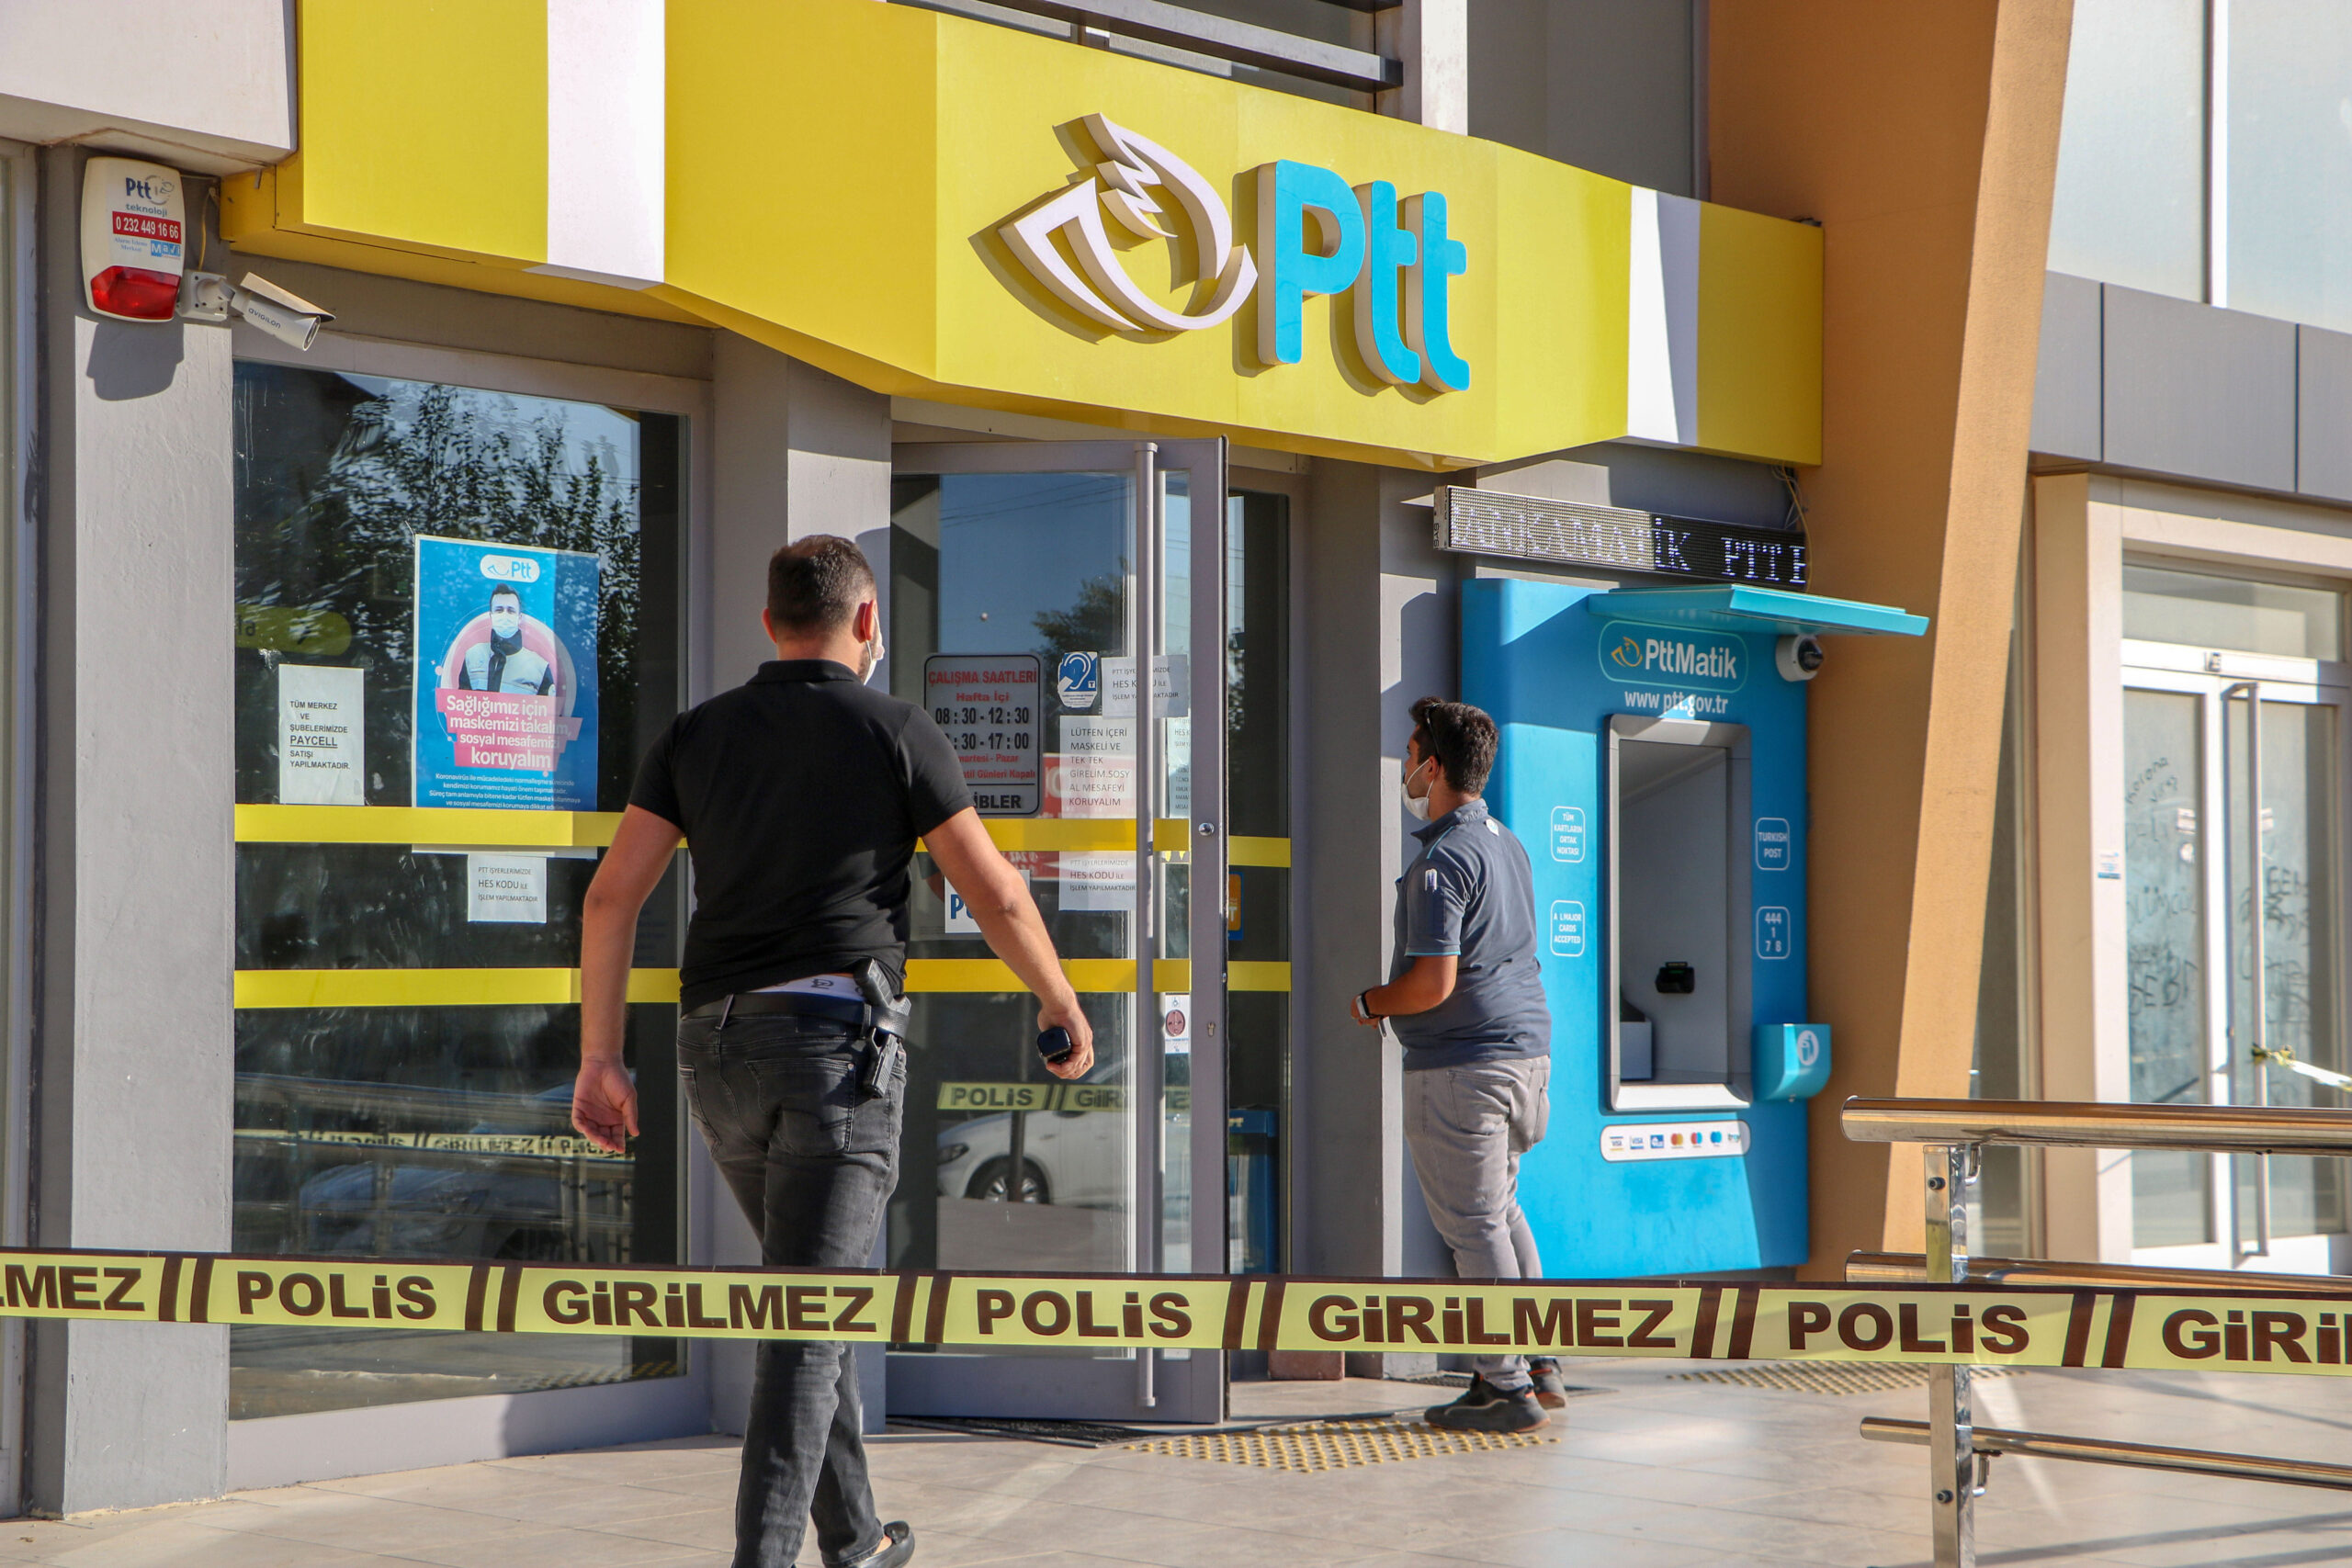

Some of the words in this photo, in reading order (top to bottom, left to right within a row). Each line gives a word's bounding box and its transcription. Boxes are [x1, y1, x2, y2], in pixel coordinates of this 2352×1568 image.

[125, 176, 152, 200] Ptt
[126, 204, 167, 218] teknoloji
[116, 216, 121, 230] 0
[123, 217, 140, 232] 232
[141, 220, 156, 235] 449
[158, 222, 168, 237] 16
[169, 224, 179, 240] 66
[1272, 158, 1470, 391] Ptt
[512, 561, 532, 579] Ptt
[1645, 638, 1736, 680] PttMatik
[928, 671, 978, 687] ÇALIŞMA
[982, 668, 1037, 684] SAATLERİ
[1113, 681, 1129, 689] HES
[956, 693, 990, 702] Hafta
[994, 691, 1010, 703] İçi
[290, 700, 306, 708] TÜM
[307, 702, 338, 710] MERKEZ
[447, 695, 520, 717] Sağlığımız
[522, 700, 548, 721] için
[935, 707, 950, 725] 08
[962, 707, 977, 724] 30
[989, 707, 1003, 724] 12
[1014, 707, 1030, 724] 30
[290, 724, 348, 733] ŞUBELERİMİZDE
[450, 716, 519, 733] maskemizi
[1070, 728, 1103, 737] LÜTFEN
[1106, 728, 1127, 739] İÇERİ
[290, 735, 338, 747] PAYCELL
[459, 732, 495, 750] sosyal
[497, 736, 560, 750] mesafemizi
[962, 733, 977, 750] 30
[989, 733, 1003, 750] 17
[1014, 732, 1030, 750] 00
[1070, 742, 1107, 750] MASKELİ
[1110, 742, 1121, 750] VE
[290, 750, 313, 759] SATIŞI
[471, 747, 552, 771] koruyalım
[996, 754, 1020, 762] Pazar
[1071, 756, 1085, 764] TEK
[435, 773, 469, 782] Koronavirüs
[978, 770, 1007, 779] Günleri
[1010, 770, 1035, 780] Kapalı
[1069, 784, 1080, 792] AL
[1082, 783, 1125, 792] MESAFEYİ
[429, 790, 445, 798] Süreç
[503, 802, 530, 810] korumaya
[1069, 797, 1121, 807] KORUYALIM
[1563, 812, 1575, 821] TÜM
[1560, 836, 1577, 844] ORTAK
[1758, 832, 1788, 842] TURKISH
[1556, 847, 1579, 855] NOKTASI
[1764, 849, 1782, 858] POST
[1070, 872, 1087, 880] HES
[1089, 872, 1114, 880] KODU
[478, 880, 494, 888] HES
[496, 881, 519, 889] KODU
[1765, 912, 1781, 925] 444
[1558, 924, 1577, 932] CARDS
[1554, 935, 1581, 944] ACCEPTED
[0, 1265, 145, 1311] MEZ
